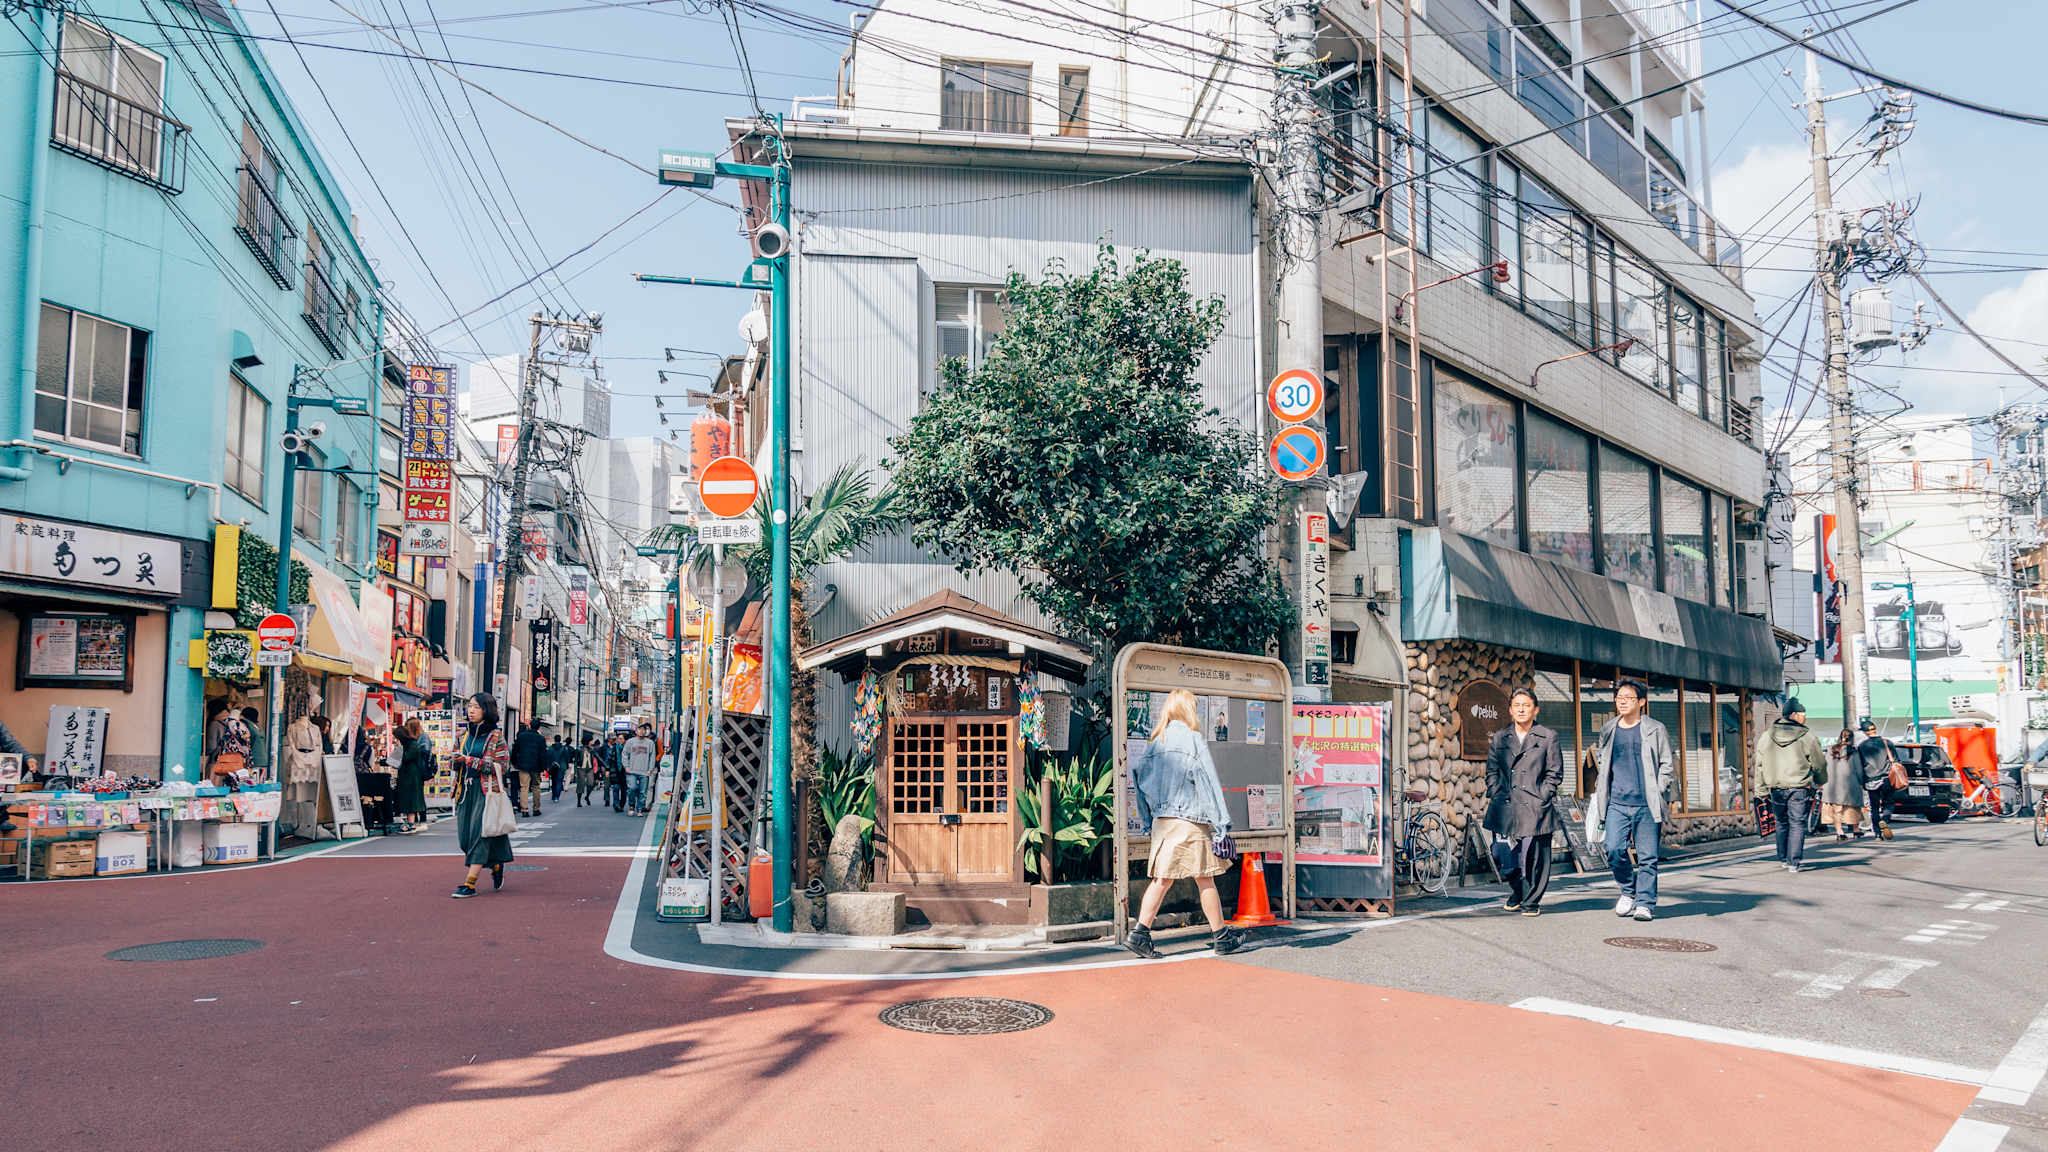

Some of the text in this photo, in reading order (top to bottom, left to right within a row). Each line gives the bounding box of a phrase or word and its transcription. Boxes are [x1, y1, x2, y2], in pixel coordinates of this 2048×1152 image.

[1281, 384, 1311, 407] 30
[409, 462, 419, 471] 2F
[409, 477, 449, 489] 買います
[408, 495, 447, 508] ゲーム
[407, 508, 448, 519] 買います
[14, 521, 77, 543] 家庭料理
[702, 525, 757, 539] 自転車を除く
[1312, 554, 1328, 618] きくや
[113, 859, 136, 867] BOX
